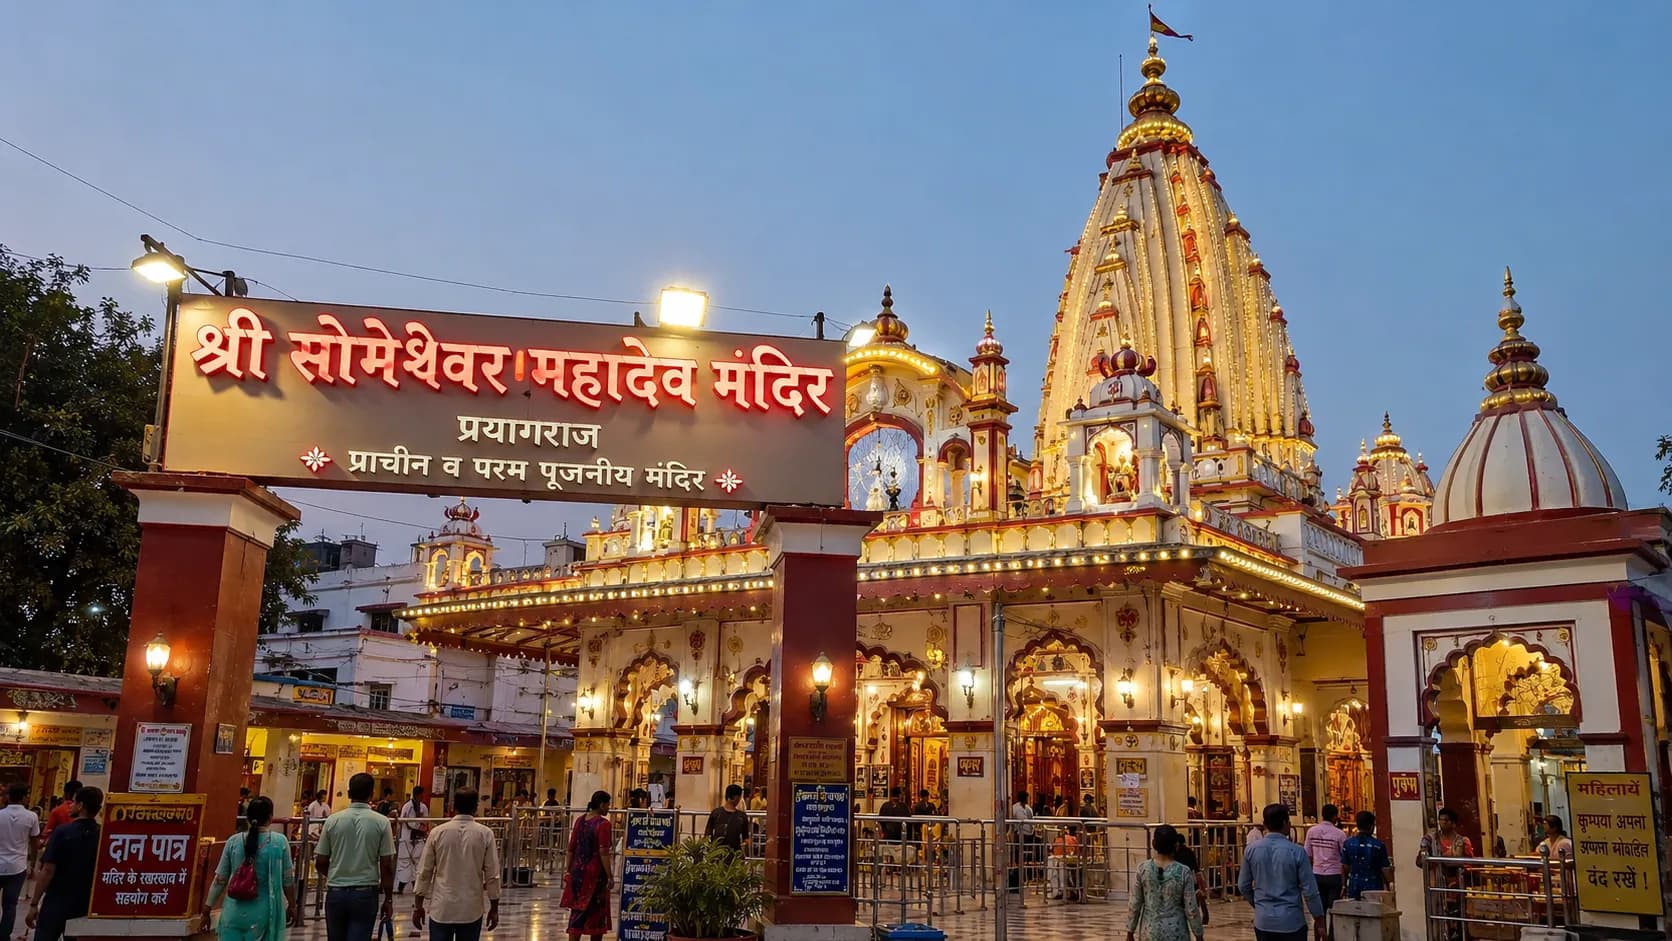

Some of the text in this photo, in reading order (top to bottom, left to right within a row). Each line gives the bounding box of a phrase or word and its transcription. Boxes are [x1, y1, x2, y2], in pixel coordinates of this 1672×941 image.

[191, 308, 275, 381] श्री
[527, 336, 698, 409] महादेव
[710, 344, 835, 417] मंदिर
[456, 415, 602, 449] प्रयागराज
[347, 445, 707, 491] प्राचीन व परम पूजनीय मंदिर
[109, 834, 190, 863] दान पात्र
[127, 868, 138, 885] के
[178, 868, 188, 885] में
